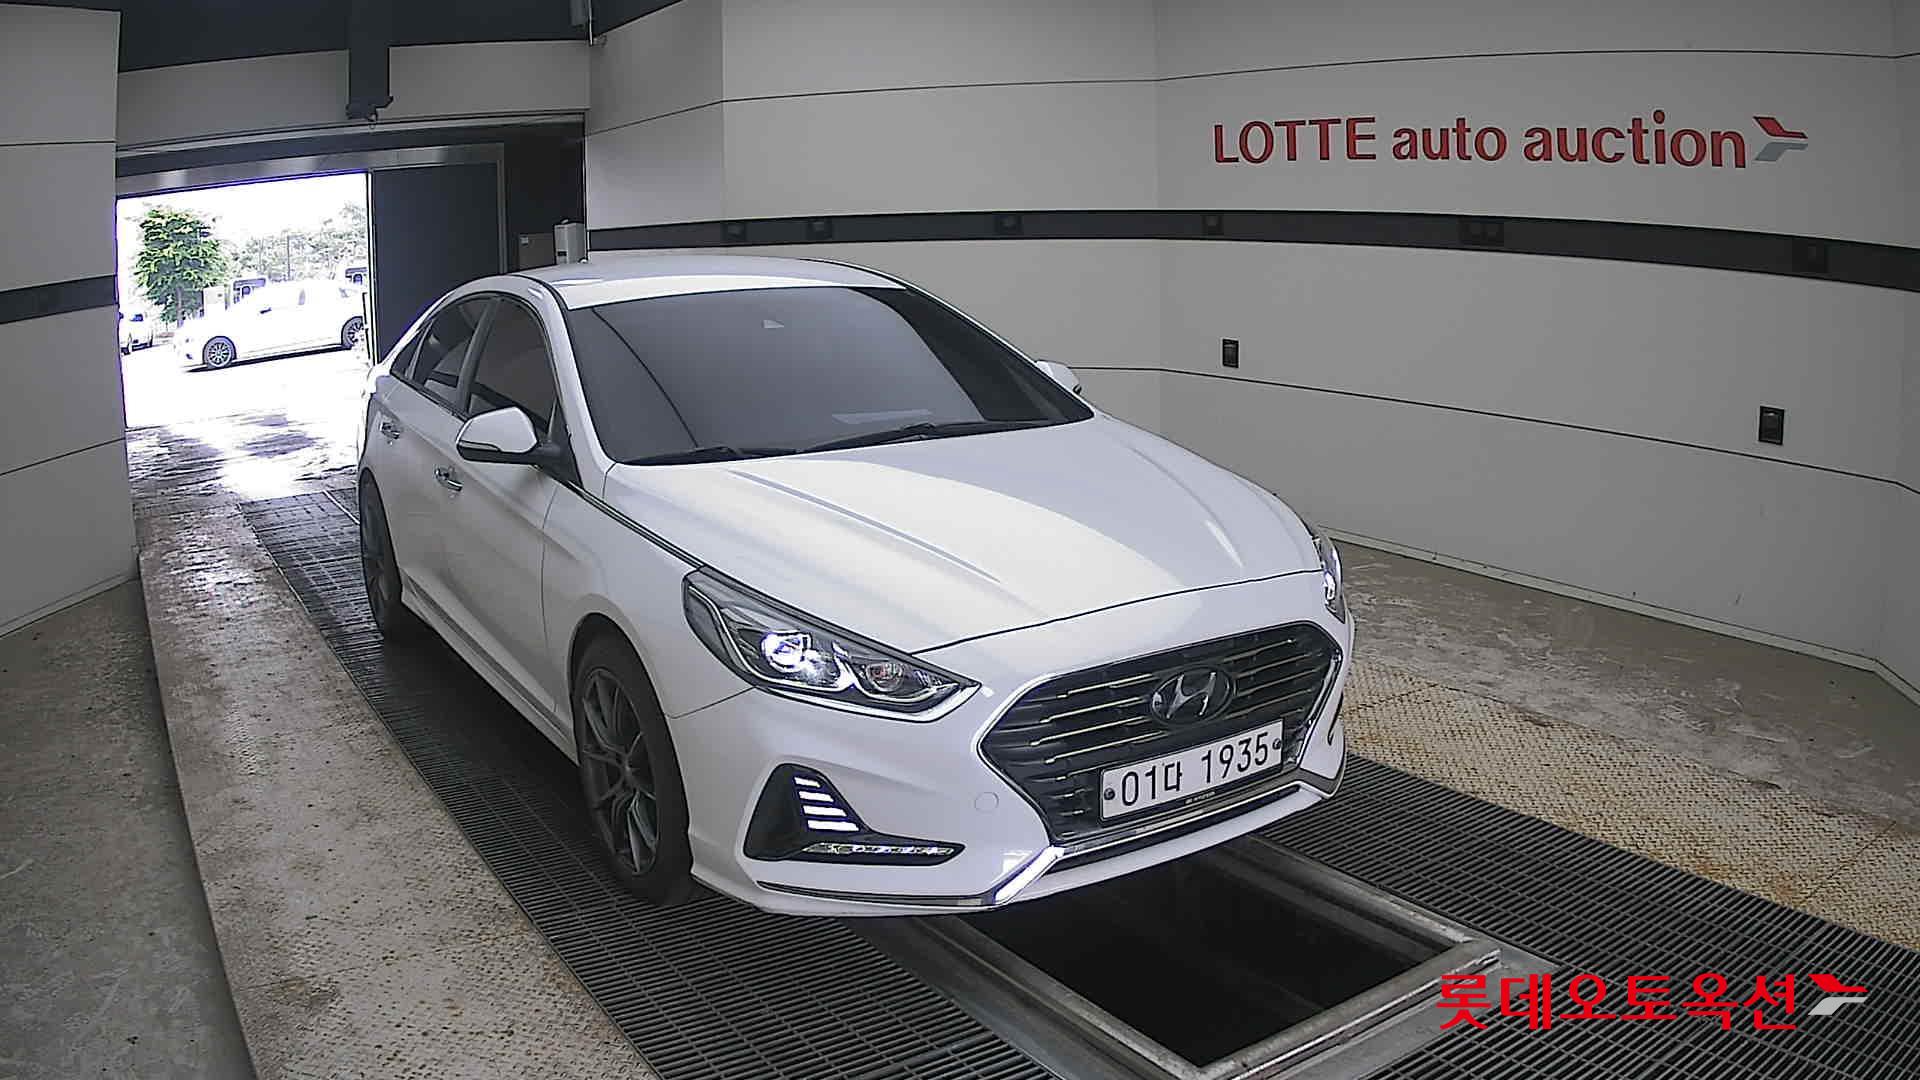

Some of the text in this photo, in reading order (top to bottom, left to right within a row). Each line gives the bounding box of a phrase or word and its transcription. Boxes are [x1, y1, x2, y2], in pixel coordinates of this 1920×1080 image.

[1213, 110, 1747, 168] LOTTE auto auction
[1121, 732, 1268, 806] 01다 1935
